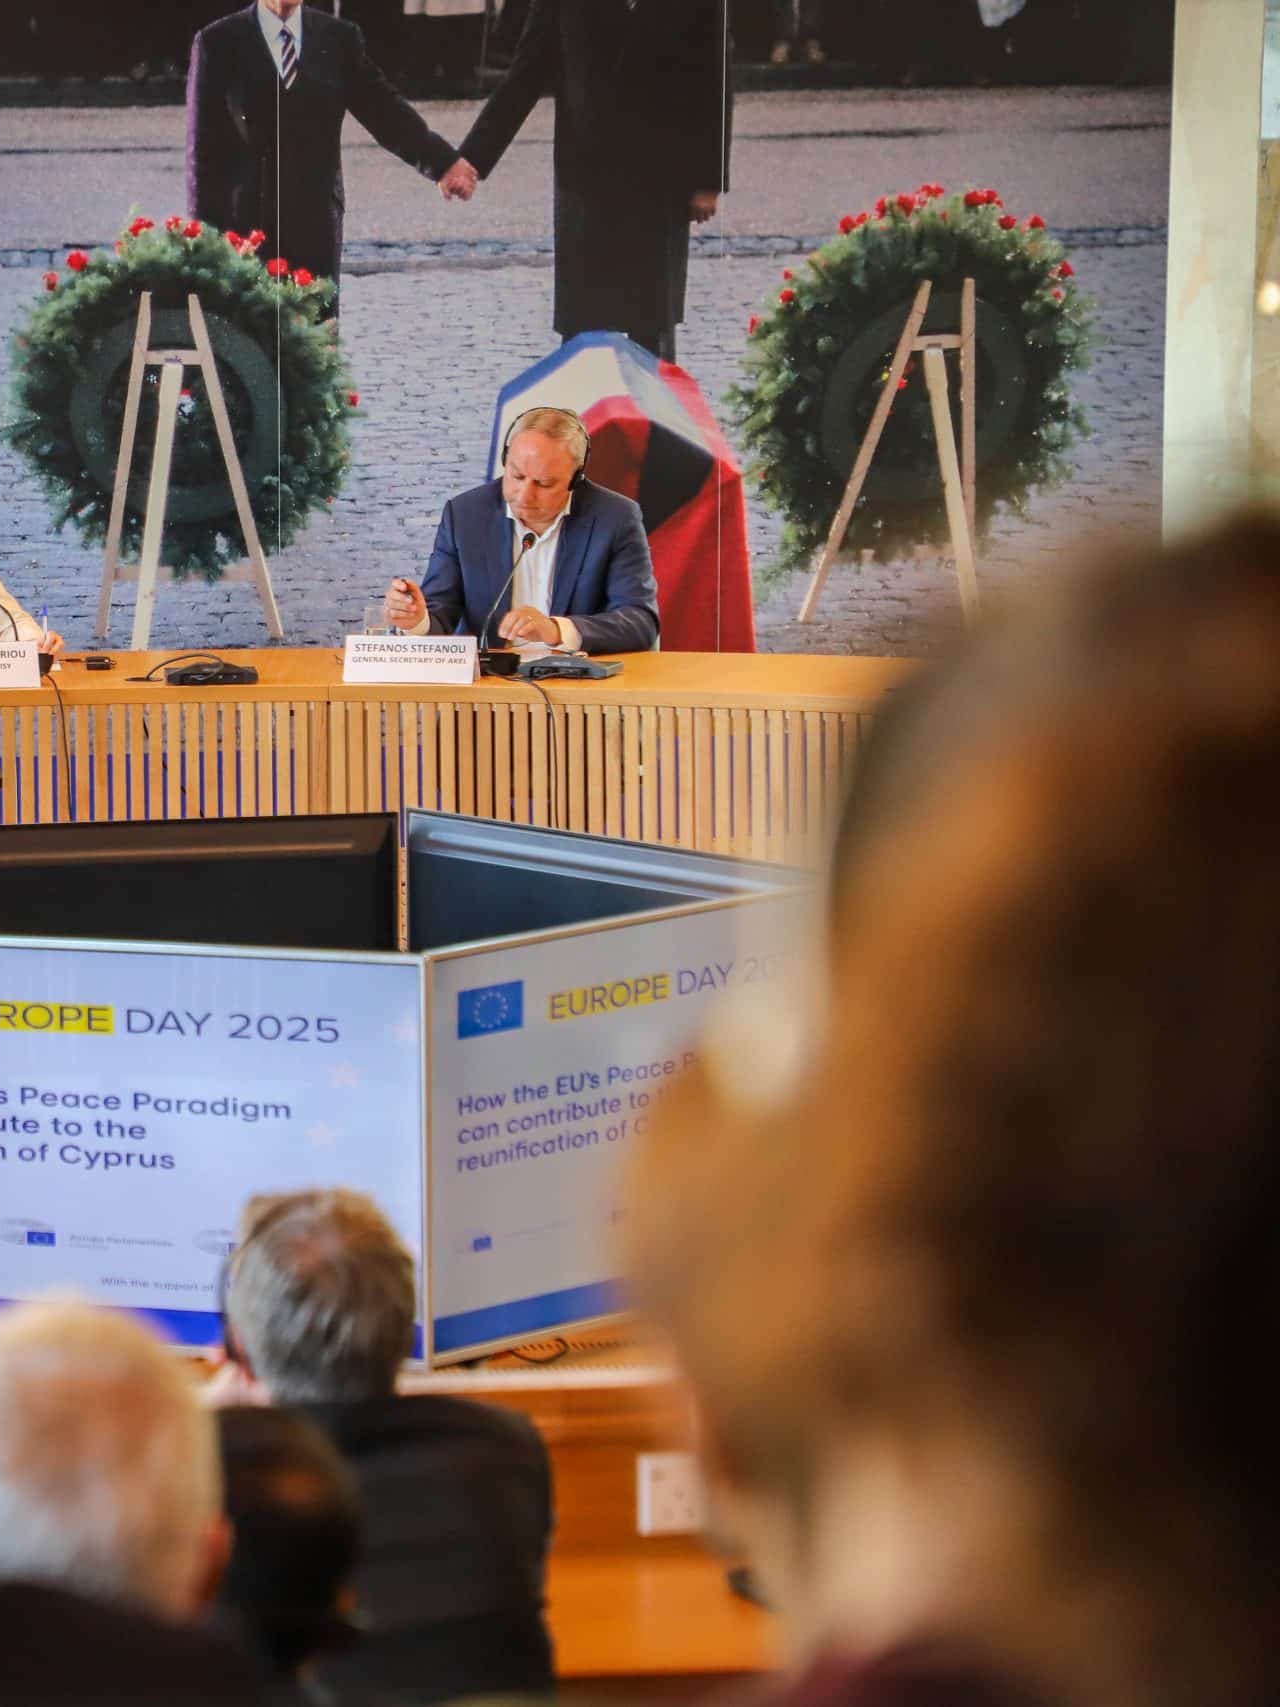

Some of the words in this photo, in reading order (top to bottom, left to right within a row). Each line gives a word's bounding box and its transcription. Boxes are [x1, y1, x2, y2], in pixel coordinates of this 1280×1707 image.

[354, 643, 408, 653] STEFANOS
[411, 644, 466, 654] STEFANOU
[389, 656, 433, 664] SECRETARY
[549, 972, 669, 1021] EUROPE
[676, 961, 734, 996] DAY
[125, 1007, 212, 1038] DAY
[228, 1013, 341, 1044] 2025
[20, 1085, 121, 1111] Peace
[132, 1091, 292, 1123] Paradigm
[457, 1092, 505, 1117] How
[513, 1083, 549, 1104] the
[607, 1058, 675, 1085] Peace
[50, 1116, 81, 1137] to
[93, 1117, 147, 1141] the
[457, 1122, 500, 1146] can
[506, 1096, 621, 1134] contribute
[629, 1090, 650, 1111] to
[17, 1140, 48, 1163] of
[58, 1144, 176, 1171] Cyprus
[456, 1130, 599, 1173] reunification
[606, 1119, 628, 1142] of
